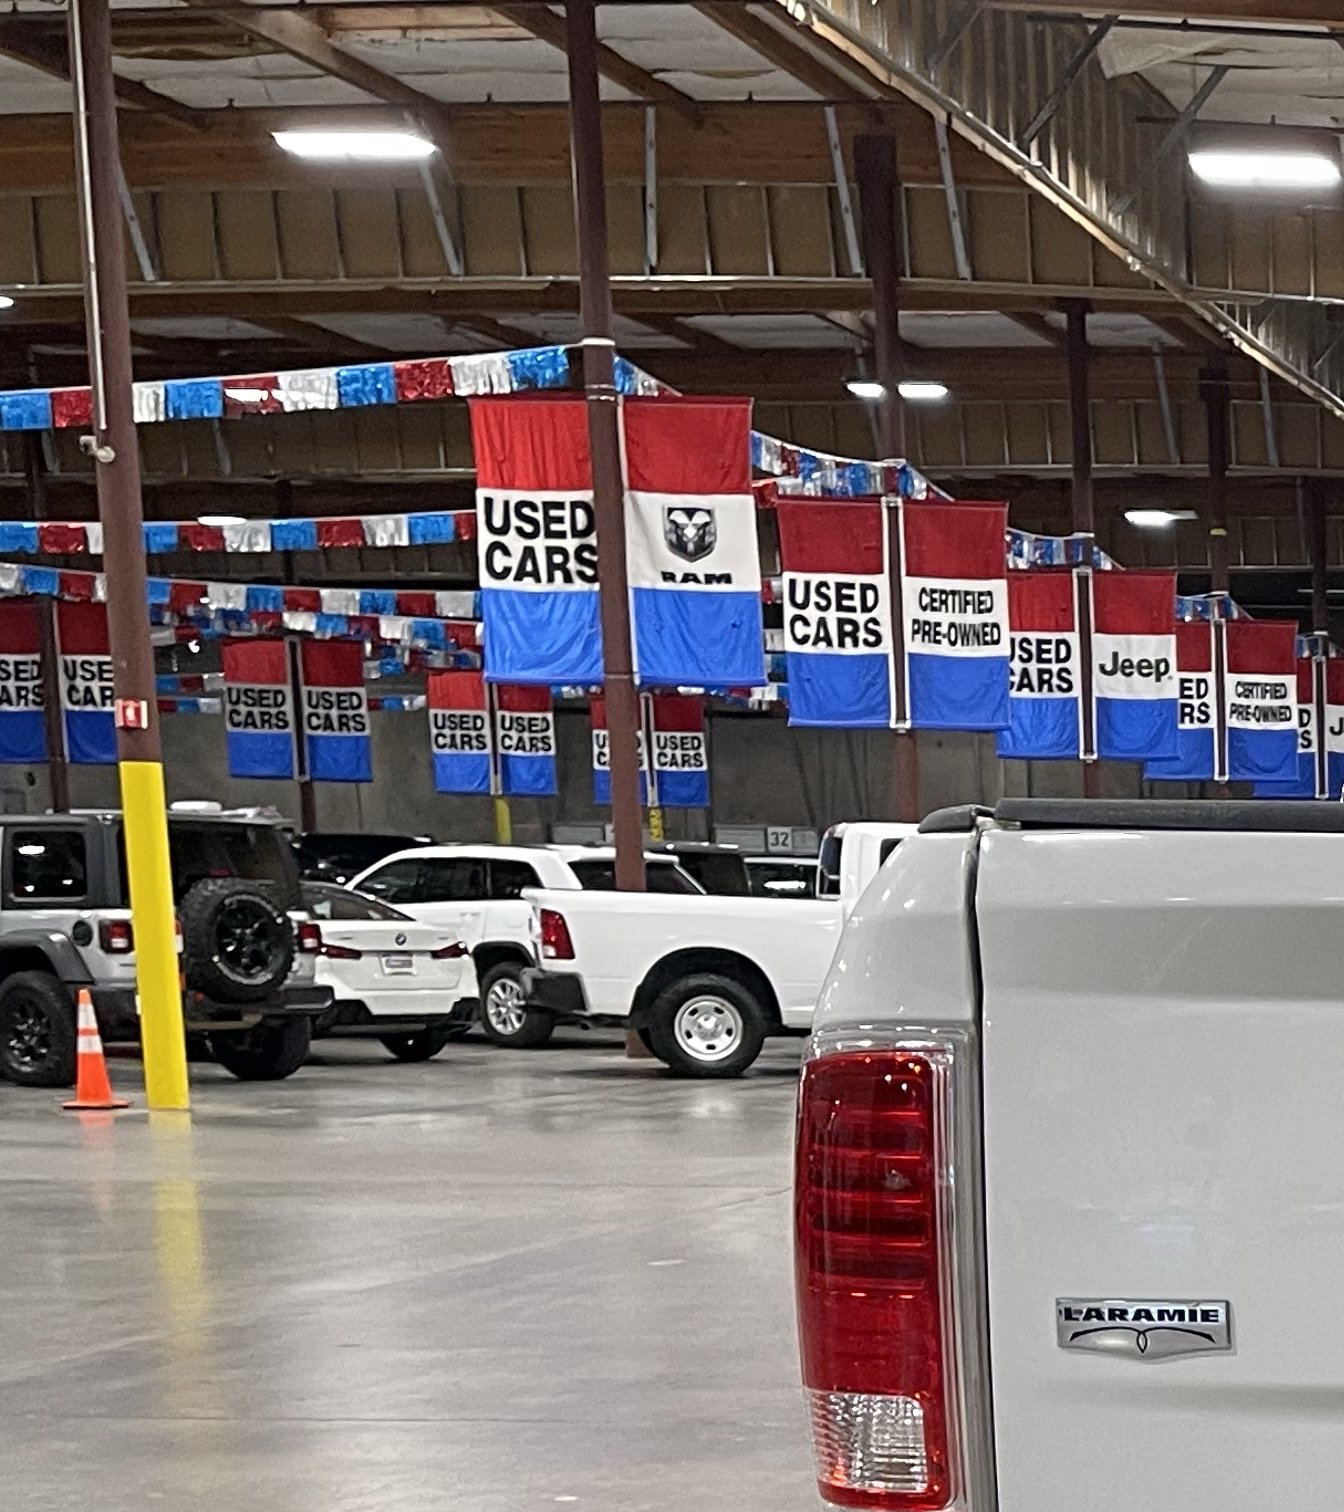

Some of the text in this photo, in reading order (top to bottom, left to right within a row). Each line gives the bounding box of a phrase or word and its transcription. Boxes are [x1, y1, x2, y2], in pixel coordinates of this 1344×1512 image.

[484, 497, 595, 539] USED
[485, 541, 598, 584] CARS
[661, 571, 732, 585] RAM
[788, 578, 879, 614] USED
[918, 587, 994, 614] CERTIFIED
[789, 614, 882, 648] CARS
[911, 618, 1001, 647] PRE-OWNED
[0, 659, 41, 682] SED
[63, 659, 114, 682] USE
[1099, 651, 1170, 683] Jeep
[0, 684, 44, 706] ARS
[67, 684, 114, 707] CAR
[227, 687, 286, 708] USED
[307, 690, 363, 711] USED
[1235, 681, 1288, 700] CERTIFIED
[228, 709, 289, 730] CARS
[307, 712, 366, 732] CARS
[434, 713, 485, 731] USED
[1229, 703, 1292, 723] PRE-OWNED
[501, 715, 551, 733] USED
[434, 733, 487, 750] CARS
[501, 734, 552, 752] CARS
[656, 735, 701, 751] USED
[657, 752, 704, 768] CARS
[769, 831, 790, 847] 32
[1063, 1307, 1220, 1323] LARAMIE
